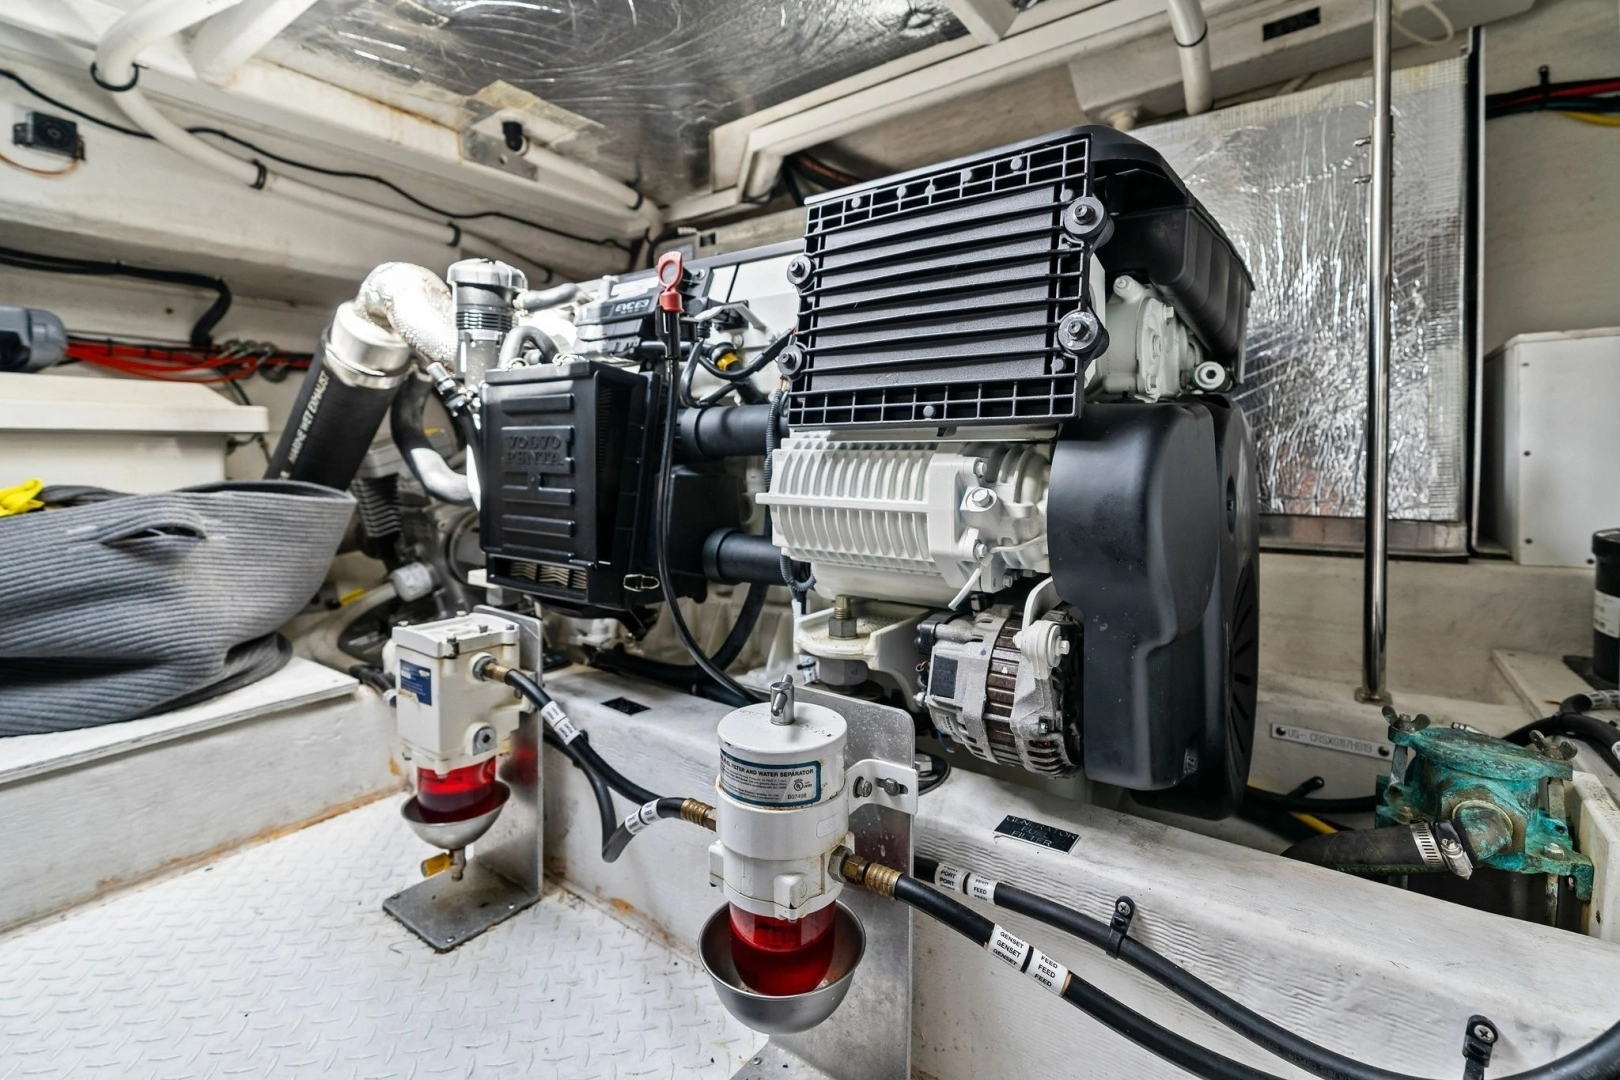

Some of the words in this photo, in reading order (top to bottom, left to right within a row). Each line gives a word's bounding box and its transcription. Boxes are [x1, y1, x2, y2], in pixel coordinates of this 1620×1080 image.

[299, 408, 314, 432] WET
[307, 369, 330, 414] EXHAUST
[506, 435, 562, 450] VOLVO
[505, 451, 565, 466] PENTA
[745, 768, 757, 776] AND
[780, 768, 814, 778] SEPARATOR
[1011, 830, 1053, 847] FILTER
[940, 877, 955, 886] PORT
[973, 886, 987, 895] FEED
[1000, 931, 1024, 949] GENSET
[996, 939, 1021, 958] GENSET
[993, 948, 1018, 966] GENSET
[1041, 955, 1058, 969] FEED
[1038, 964, 1056, 978] FEED
[1034, 973, 1052, 987] FEED
